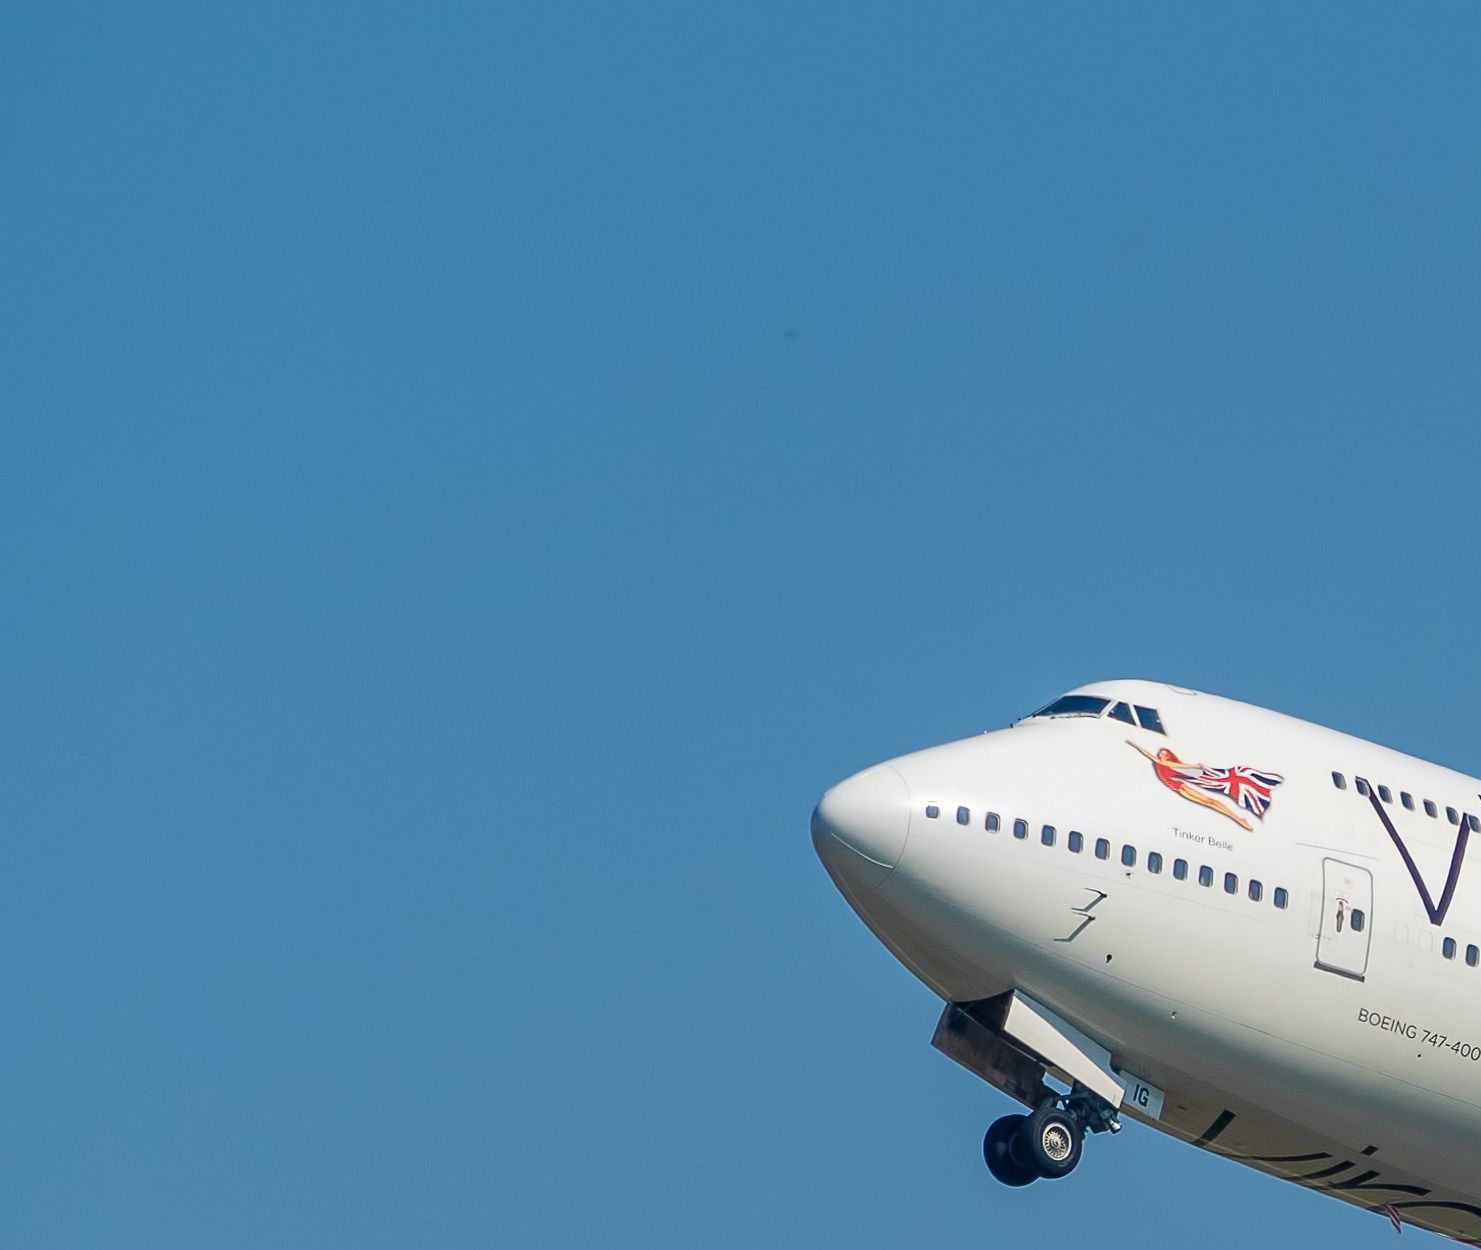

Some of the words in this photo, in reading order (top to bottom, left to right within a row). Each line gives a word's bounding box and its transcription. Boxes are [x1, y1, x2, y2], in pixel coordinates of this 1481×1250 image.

[1172, 827, 1205, 844] Tinker
[1358, 1008, 1417, 1039] BOEING
[1420, 1029, 1481, 1061] 747-400
[1133, 1084, 1150, 1107] IG
